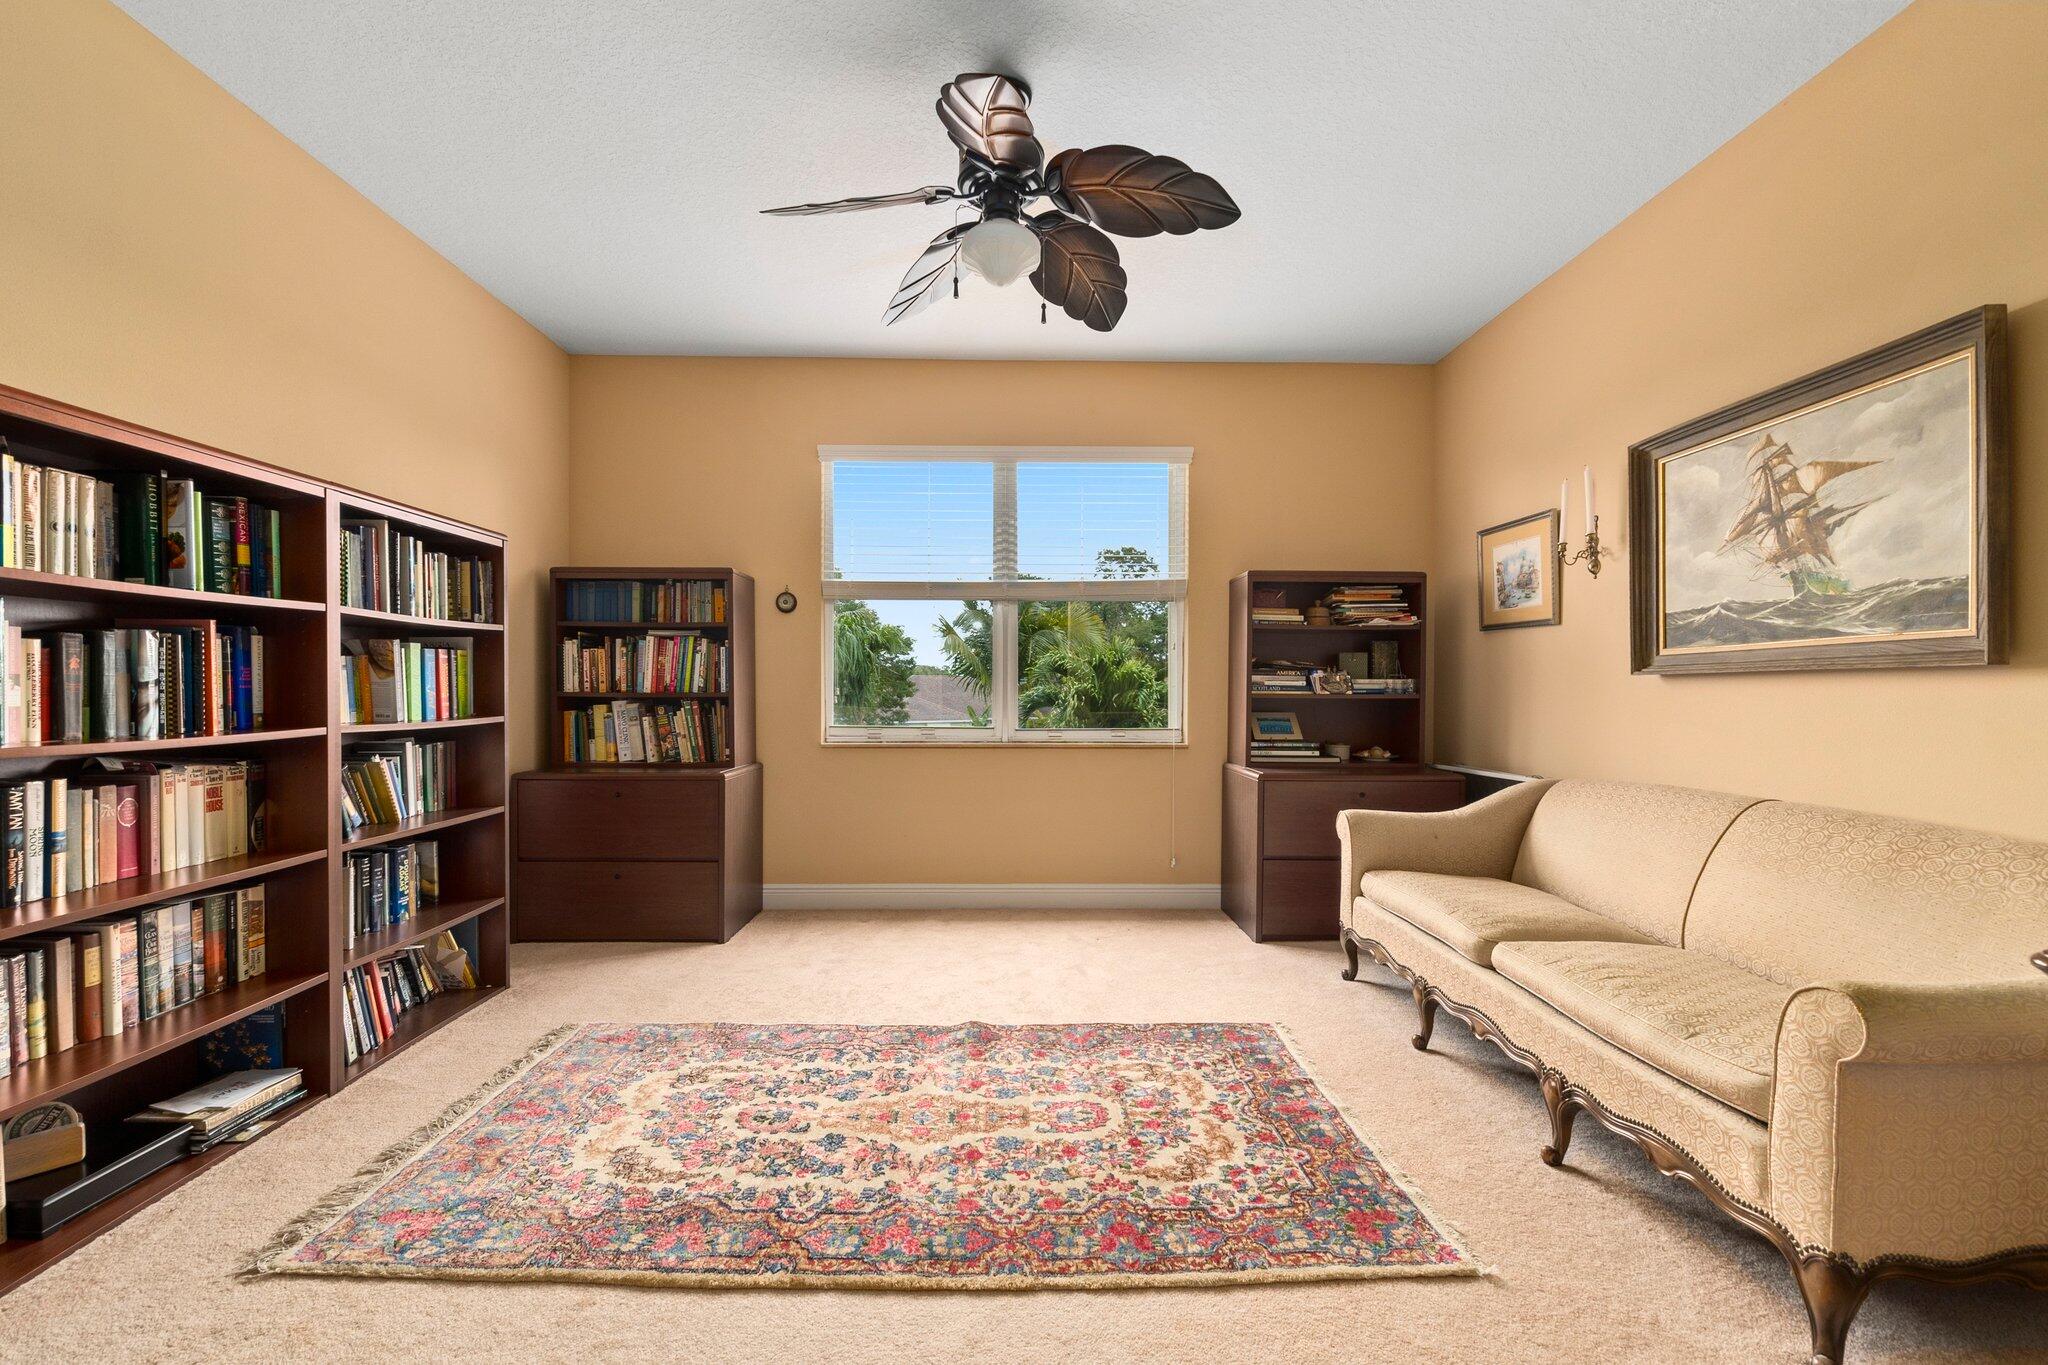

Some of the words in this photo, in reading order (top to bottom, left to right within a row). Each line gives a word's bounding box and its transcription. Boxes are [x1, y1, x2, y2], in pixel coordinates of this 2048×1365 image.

[148, 483, 158, 532] HOBBIT
[238, 502, 247, 542] MEXICAN
[206, 774, 223, 783] Clavell
[9, 790, 24, 811] AMY
[206, 786, 223, 799] NOBLE
[206, 799, 224, 813] HOUSE
[9, 812, 24, 830] TAN
[29, 828, 37, 858] MOON
[8, 858, 17, 889] DROWNING
[237, 1086, 283, 1115] SHELLS
